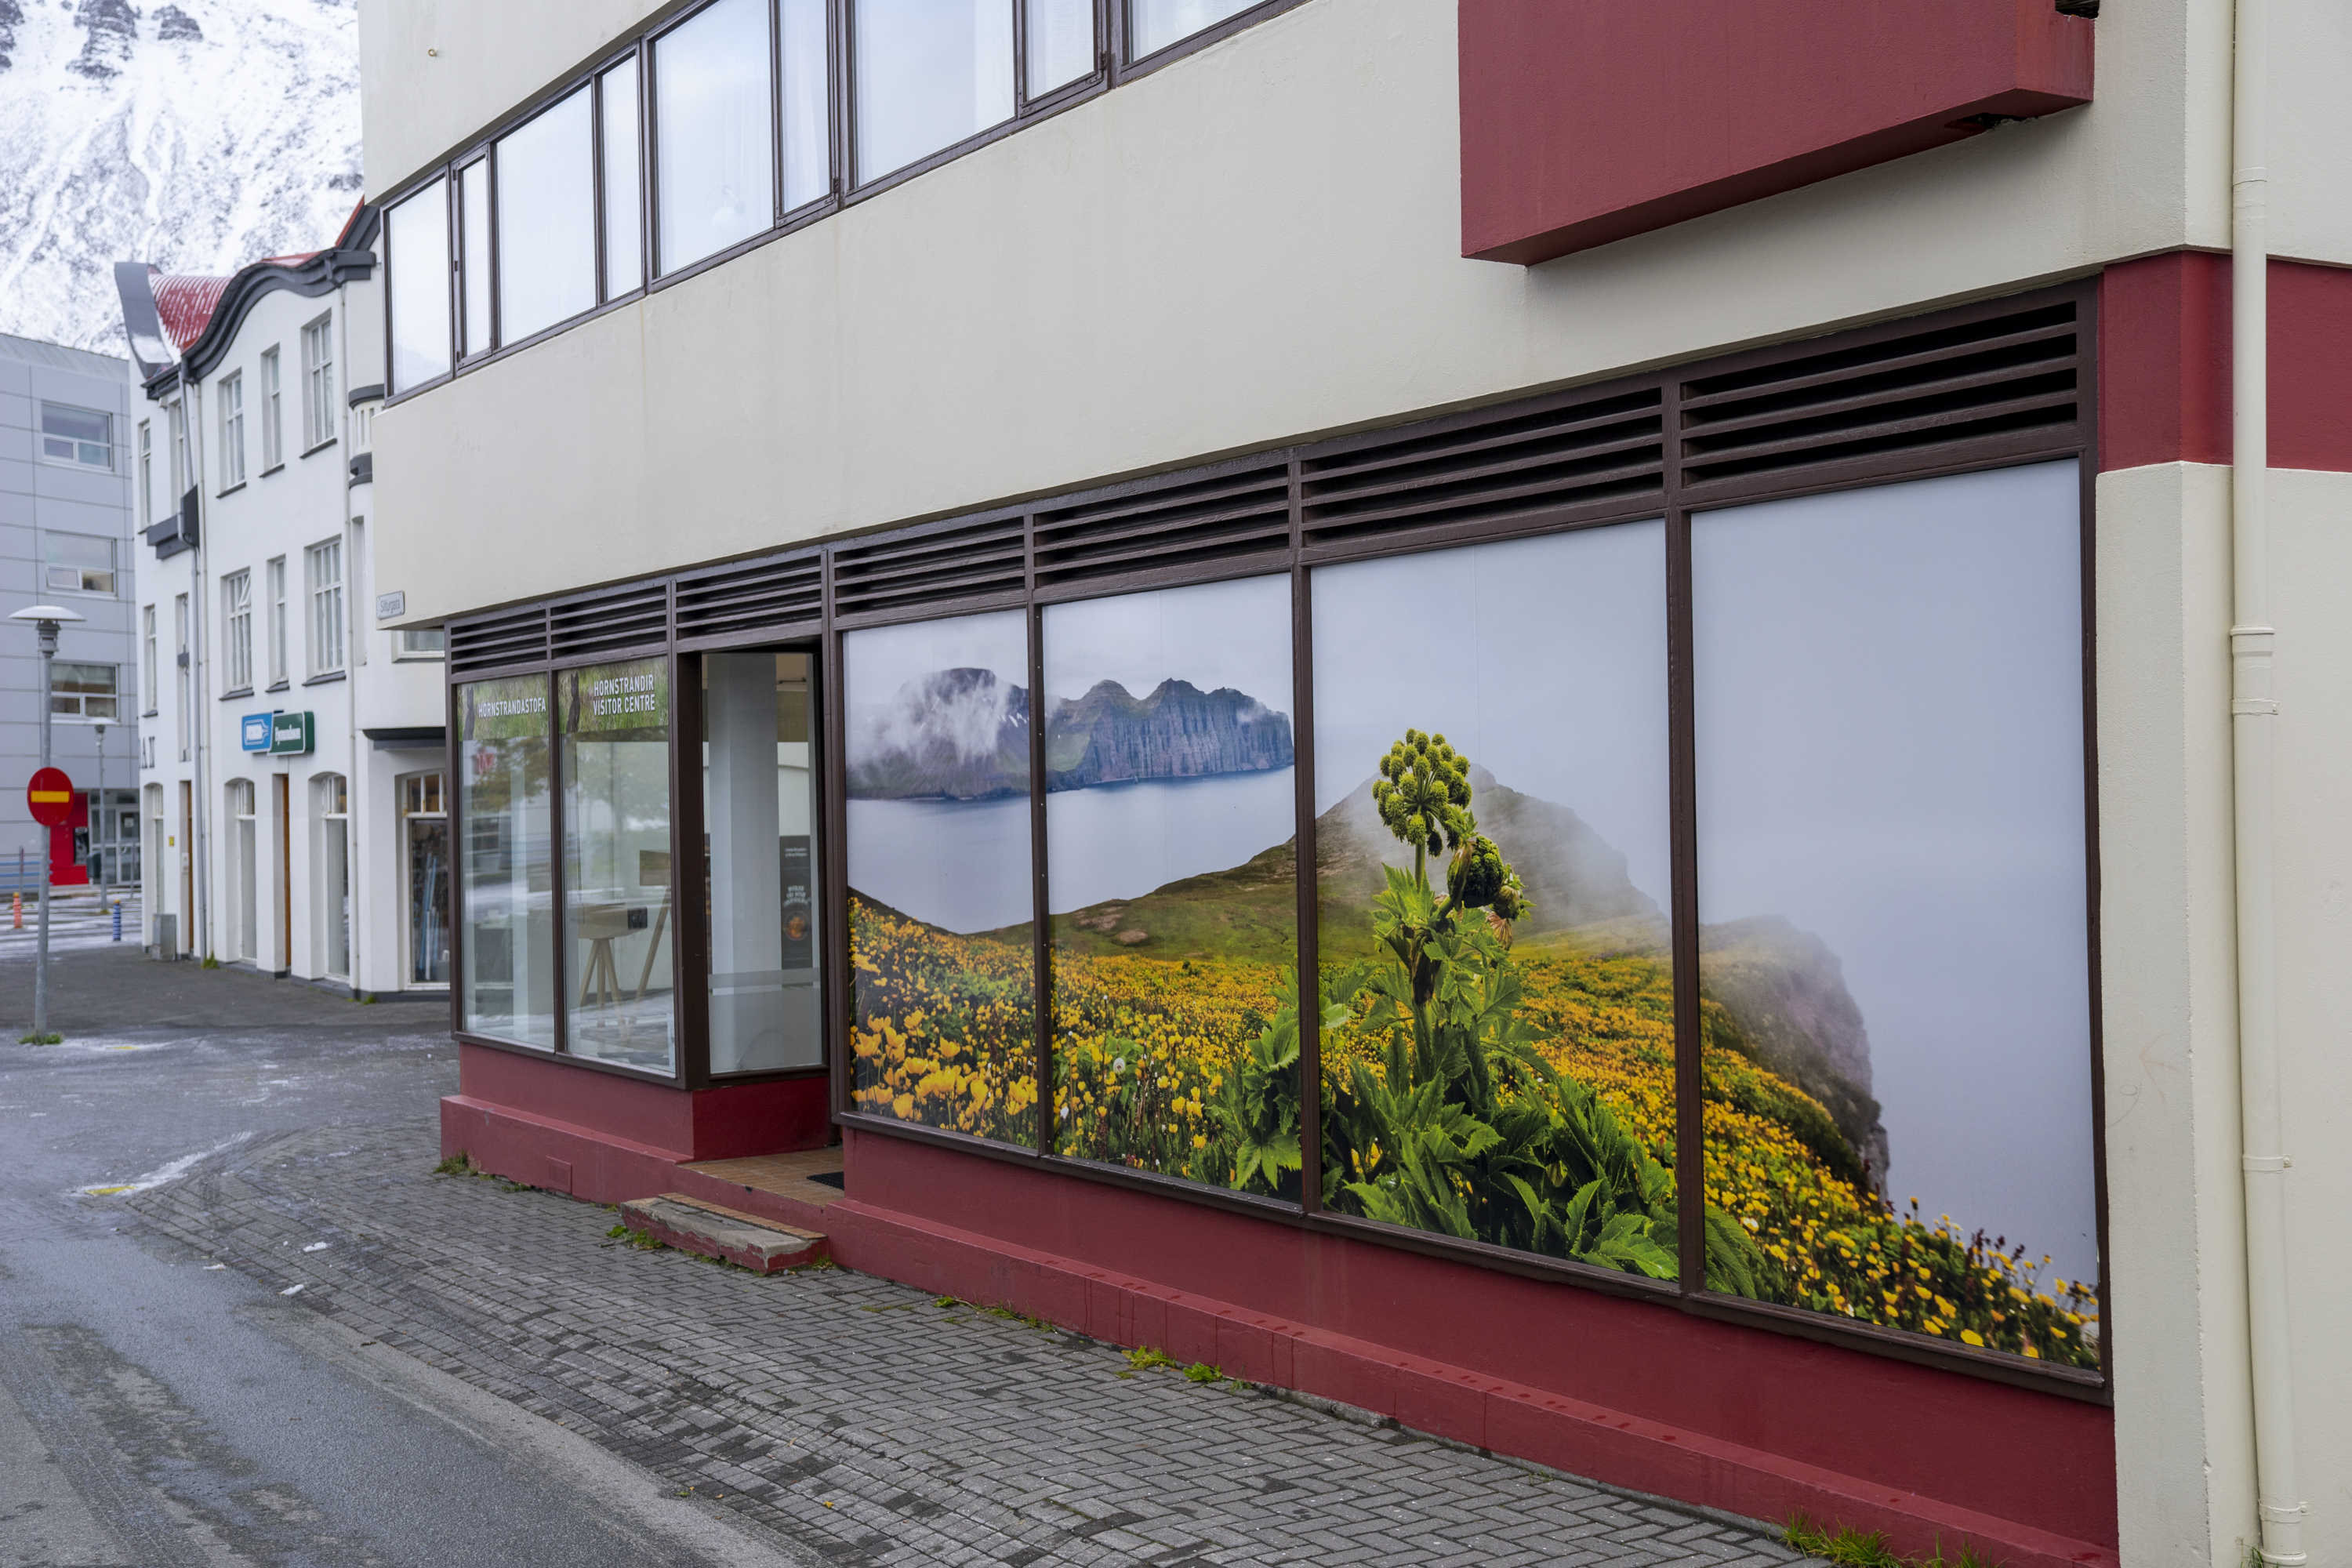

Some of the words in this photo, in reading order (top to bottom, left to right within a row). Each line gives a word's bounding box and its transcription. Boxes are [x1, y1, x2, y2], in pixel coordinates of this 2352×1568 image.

[593, 673, 654, 697] HORNSTRANDIR
[478, 696, 546, 718] HORNSTRANDASTOFA
[593, 697, 622, 716] VISITOR
[624, 693, 655, 713] CENTRE
